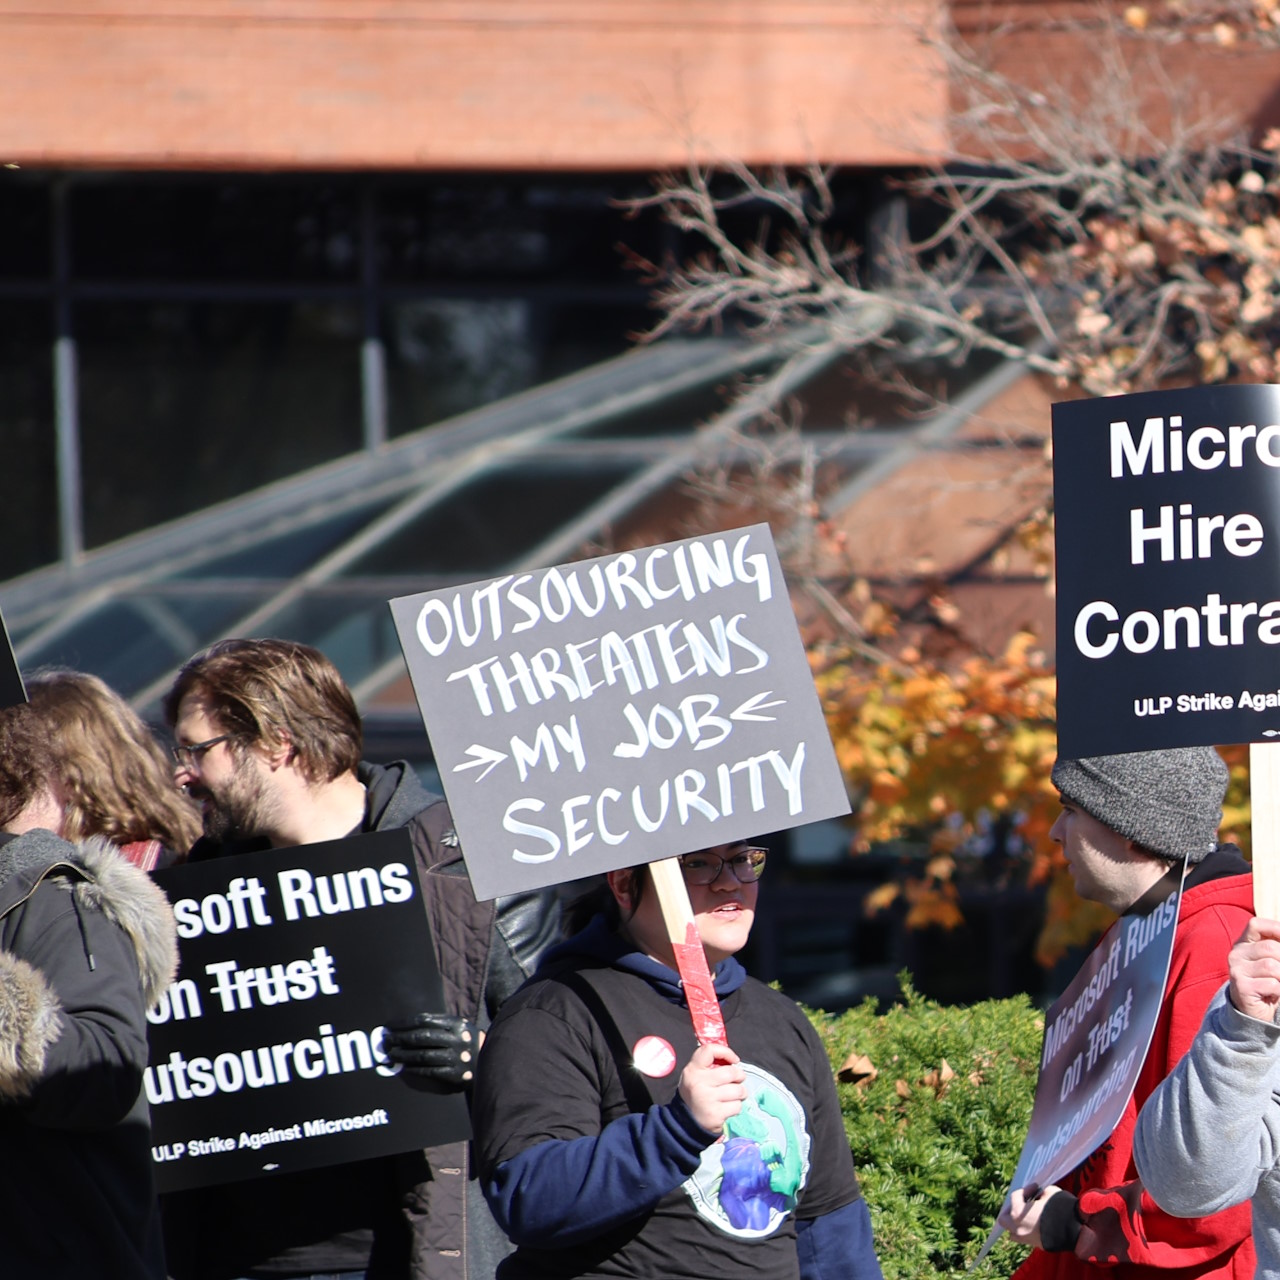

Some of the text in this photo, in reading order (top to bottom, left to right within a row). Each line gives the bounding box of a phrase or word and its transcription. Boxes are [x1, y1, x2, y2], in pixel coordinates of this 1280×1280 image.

[1130, 503, 1264, 564] Hire
[416, 534, 772, 657] OUTSOURCING
[445, 613, 769, 716] THREATENS
[1134, 696, 1173, 717] ULP
[1176, 693, 1234, 713] Strike
[509, 693, 733, 782] MY JOB
[502, 741, 806, 864] SECURITY
[277, 862, 414, 921] Runs
[205, 946, 341, 1013] Trust
[1042, 937, 1122, 1071] Microsoft
[1123, 891, 1178, 969] Runs
[1060, 1051, 1083, 1103] on
[1086, 987, 1133, 1072] Trust
[151, 1108, 389, 1164] ULP Strike Against Microsoft
